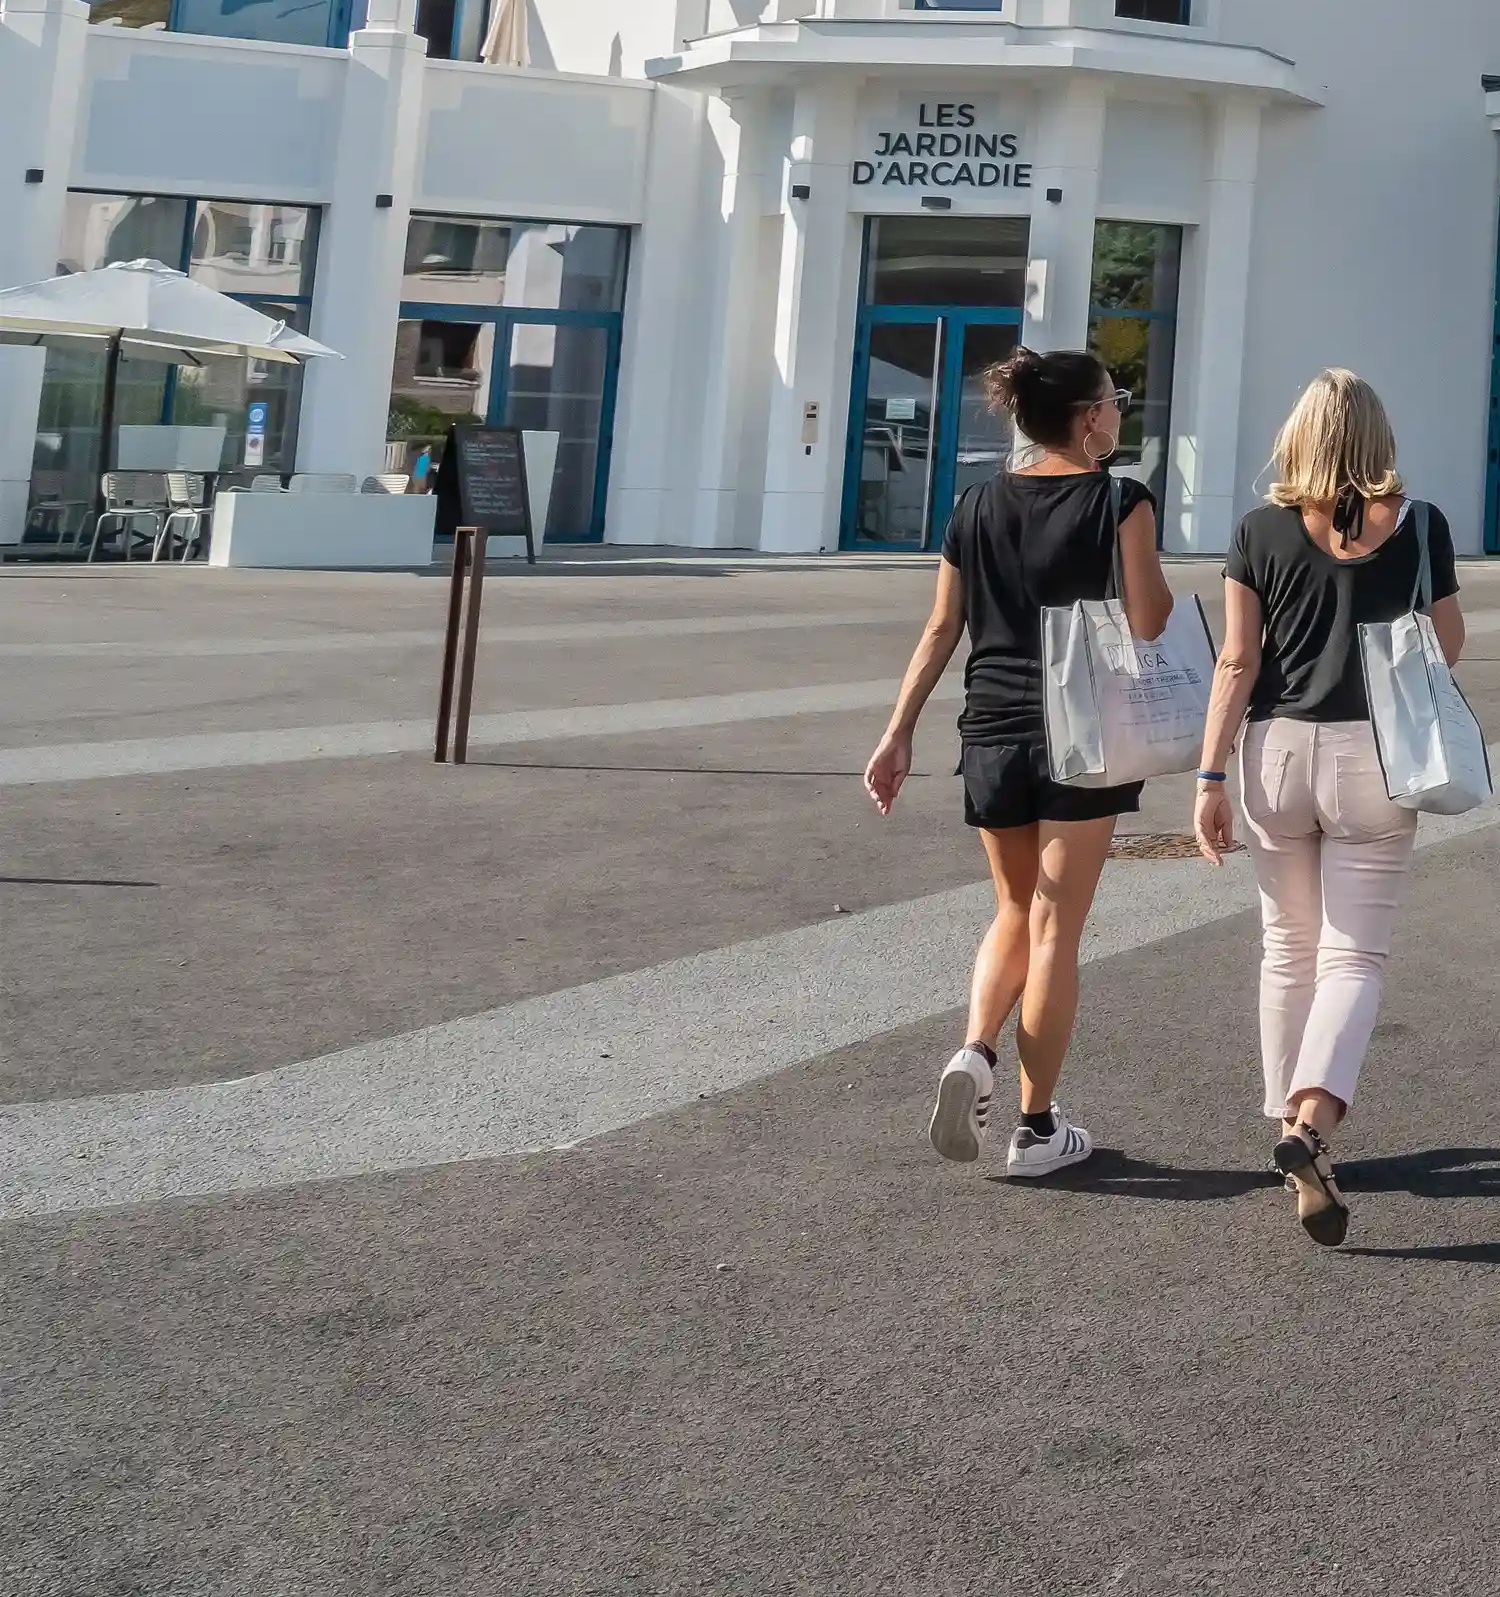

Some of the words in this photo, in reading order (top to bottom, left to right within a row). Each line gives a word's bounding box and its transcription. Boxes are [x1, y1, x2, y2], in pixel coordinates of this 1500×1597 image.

[918, 103, 975, 127] LES
[874, 132, 1018, 158] JARDINS
[852, 160, 1033, 187] D’ARCADIE
